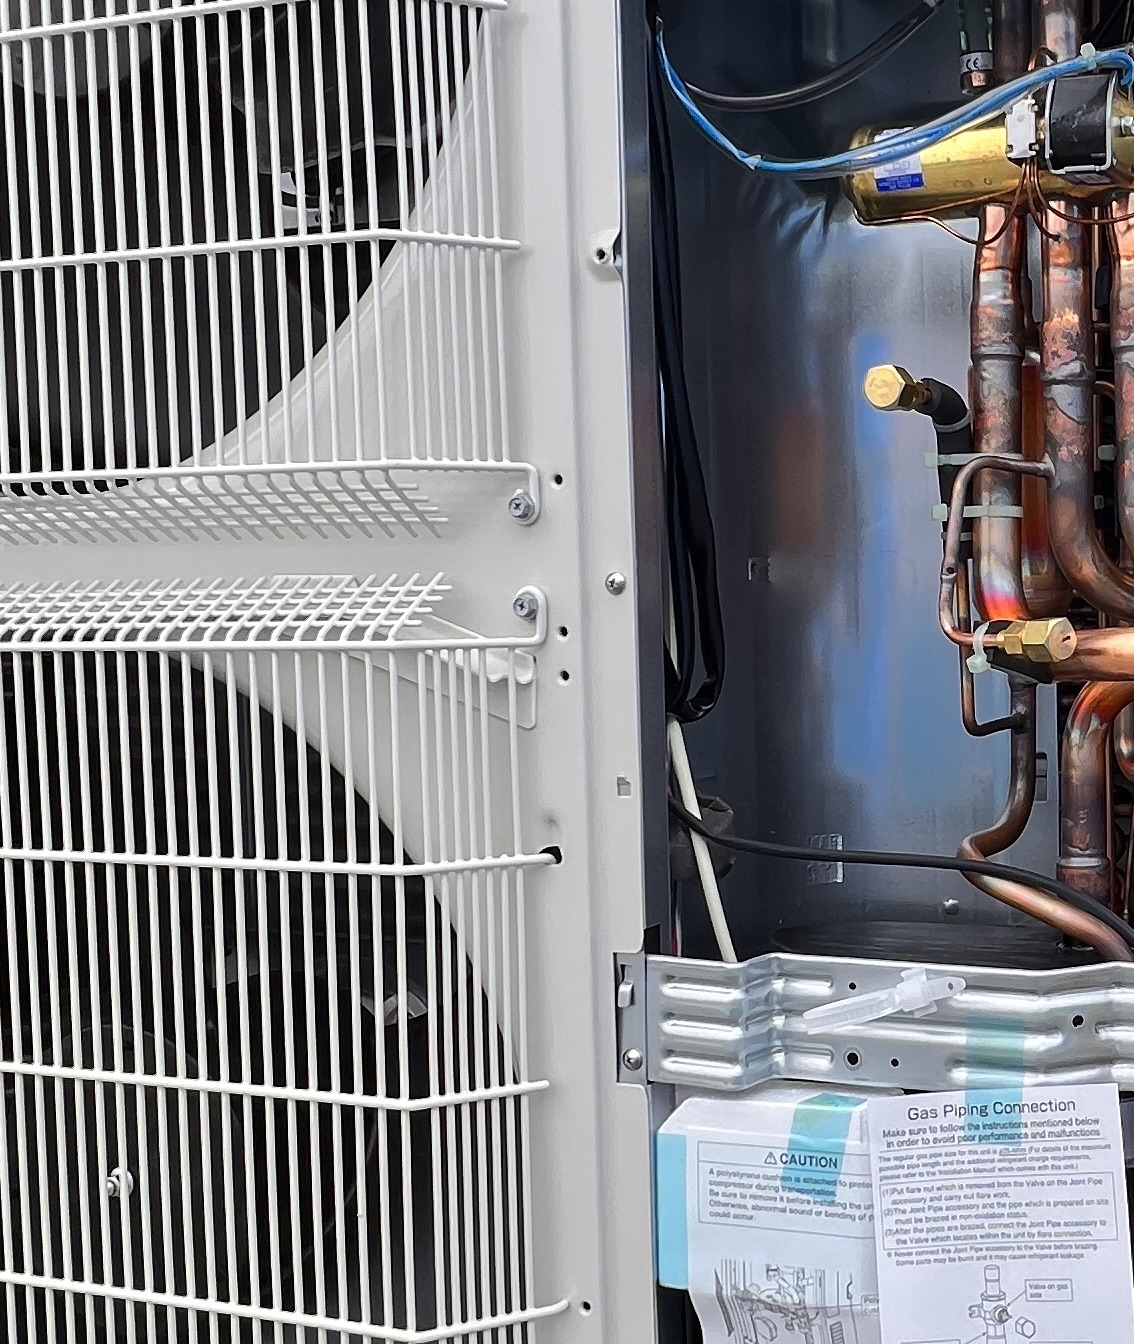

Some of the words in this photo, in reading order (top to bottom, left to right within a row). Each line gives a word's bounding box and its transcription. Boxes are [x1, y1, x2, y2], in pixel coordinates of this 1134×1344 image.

[908, 1108, 938, 1120] Gas
[944, 1104, 988, 1117] Piping
[993, 1098, 1076, 1114] Connection
[883, 1129, 906, 1138] Make
[909, 1127, 927, 1135] sure
[940, 1124, 965, 1132] follow
[982, 1120, 1028, 1130] instructions
[1030, 1118, 1073, 1128] mentioned
[1075, 1117, 1100, 1125] below
[897, 1138, 919, 1146] order
[921, 1137, 930, 1145] to
[933, 1135, 955, 1144] avoid
[958, 1135, 975, 1144] poor
[978, 1131, 1028, 1143] performance
[1048, 1128, 1100, 1138] malfunctions
[780, 1153, 837, 1168] CAUTION
[755, 1184, 779, 1193] during
[787, 1197, 811, 1205] before
[789, 1207, 812, 1215] sound
[825, 1210, 856, 1222] bending
[858, 1213, 866, 1221] of
